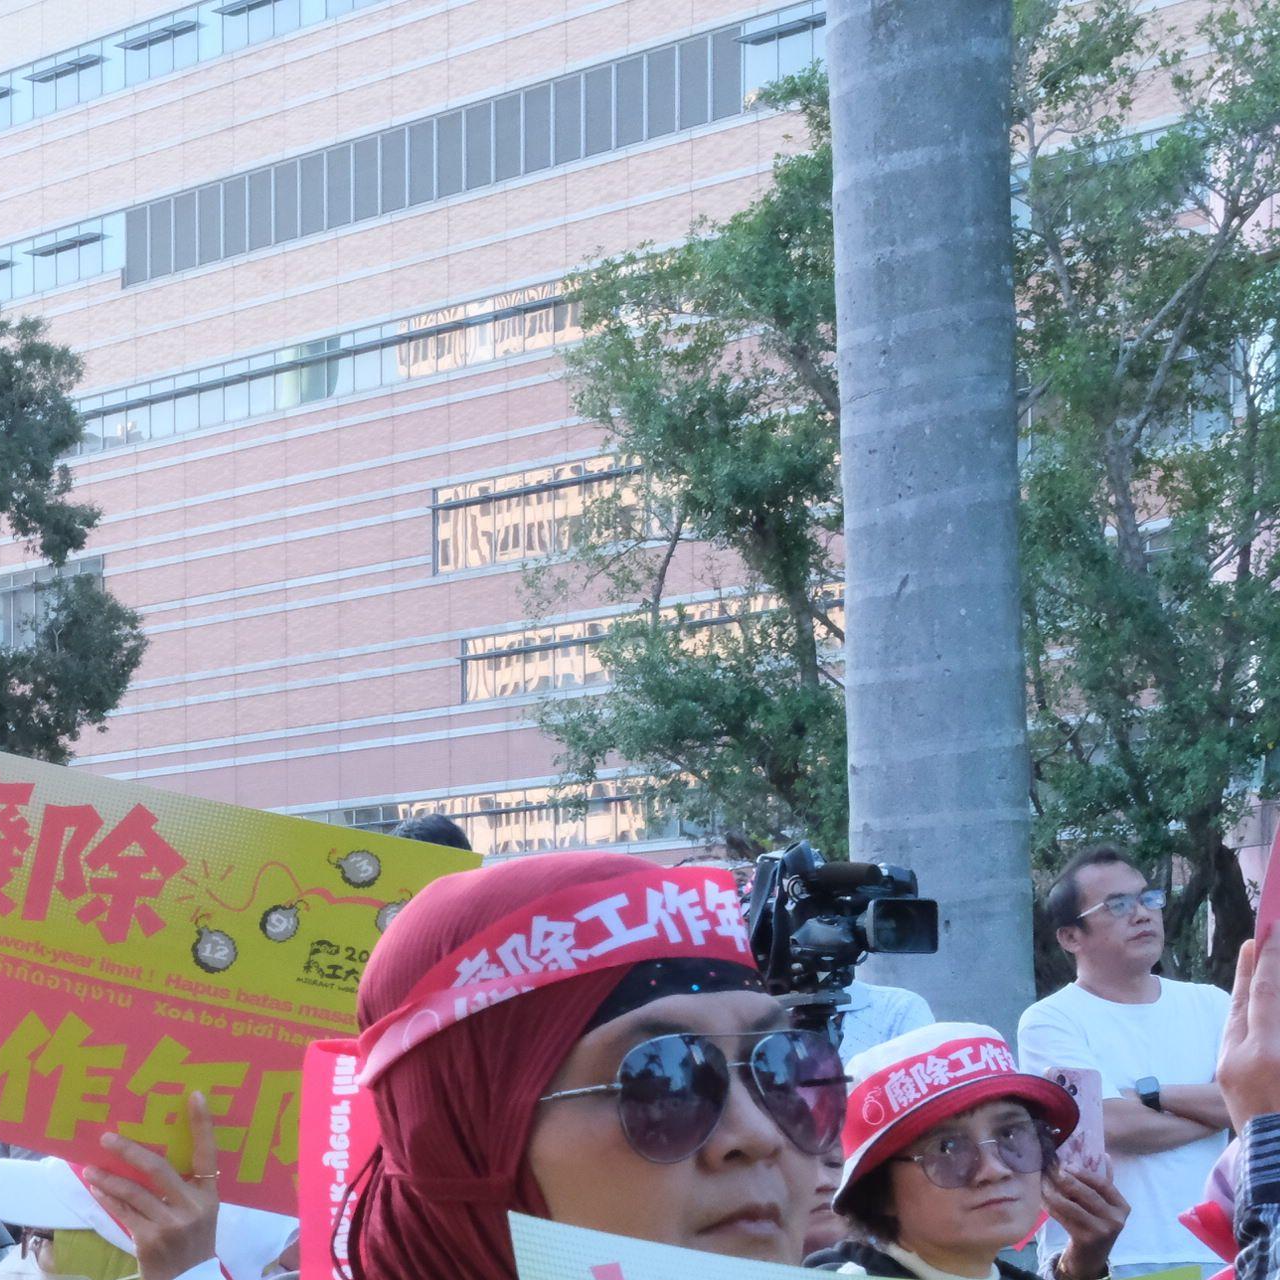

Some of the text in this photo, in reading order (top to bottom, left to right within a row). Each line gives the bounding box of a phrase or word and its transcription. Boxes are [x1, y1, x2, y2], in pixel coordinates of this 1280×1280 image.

[202, 943, 230, 961] 12
[165, 972, 231, 1000] Hapus
[236, 987, 294, 1013] batas
